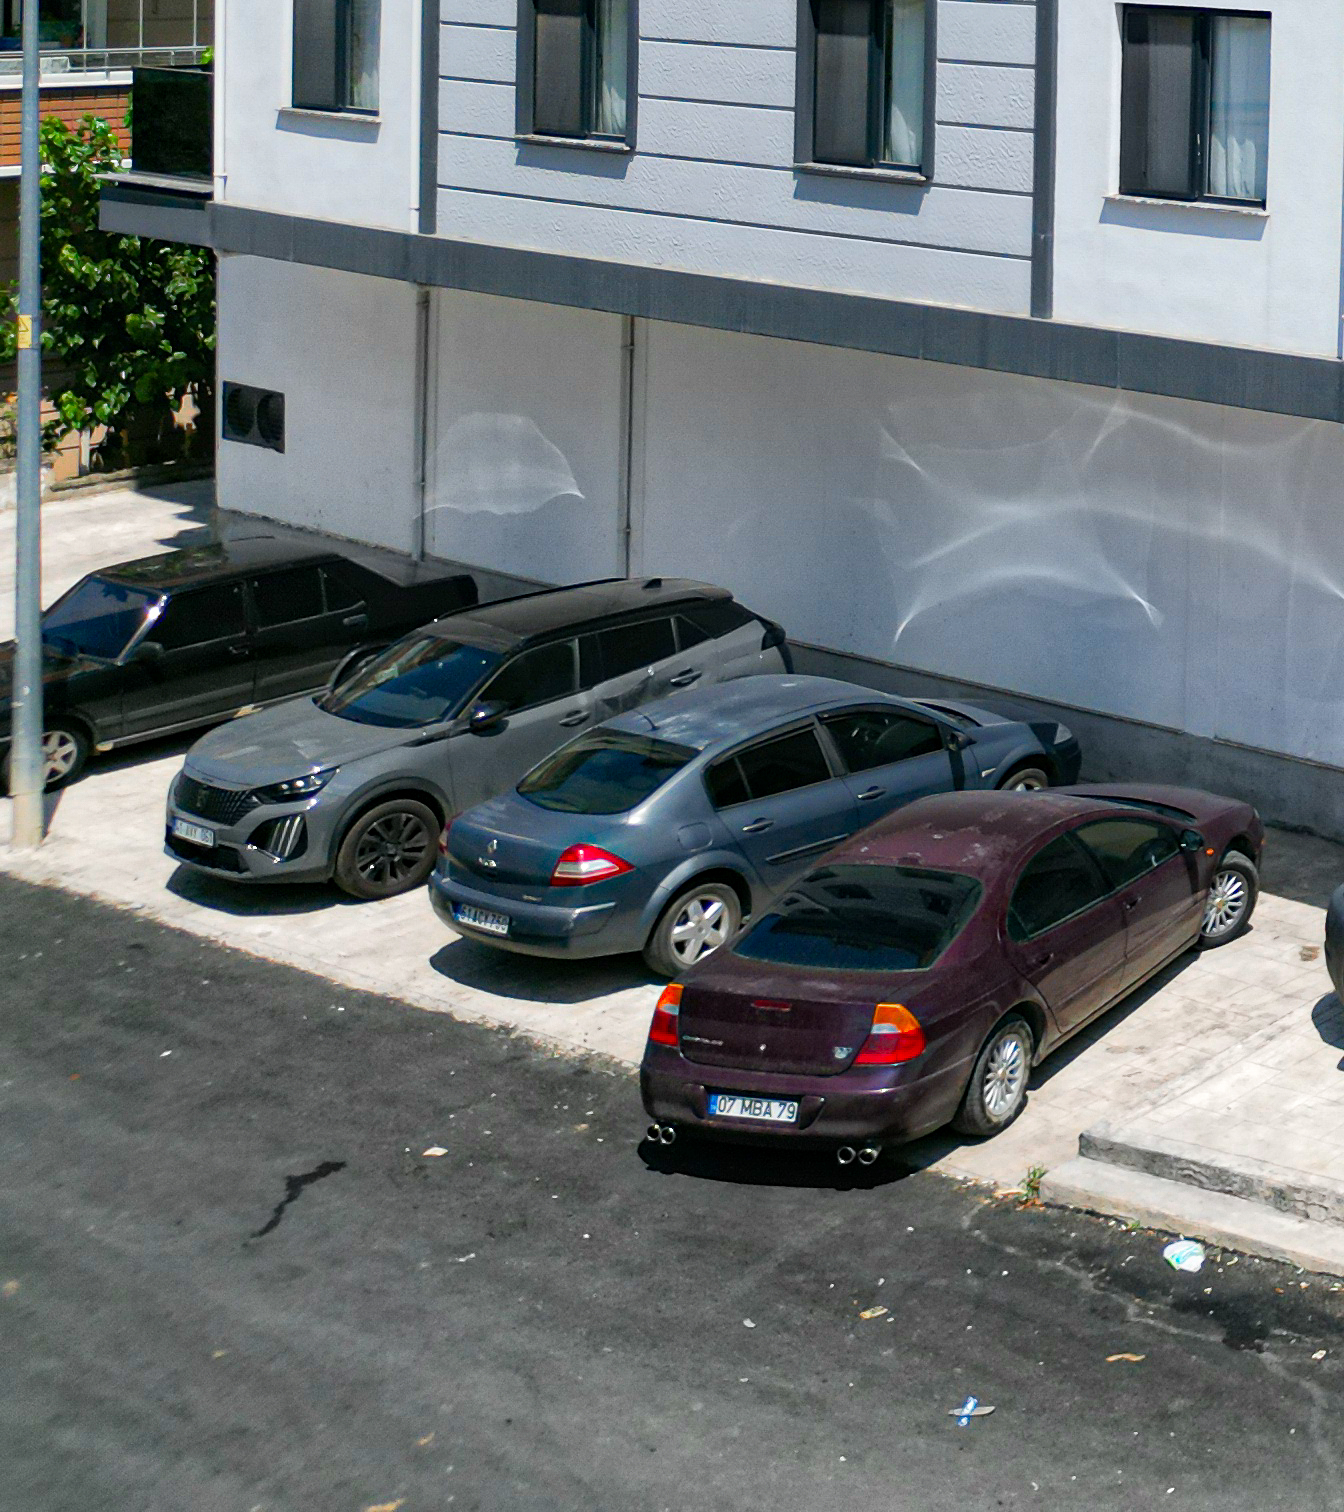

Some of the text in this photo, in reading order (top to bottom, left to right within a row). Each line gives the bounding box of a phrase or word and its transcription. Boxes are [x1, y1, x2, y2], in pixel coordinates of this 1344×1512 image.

[718, 1096, 796, 1120] 07 MBA 79
